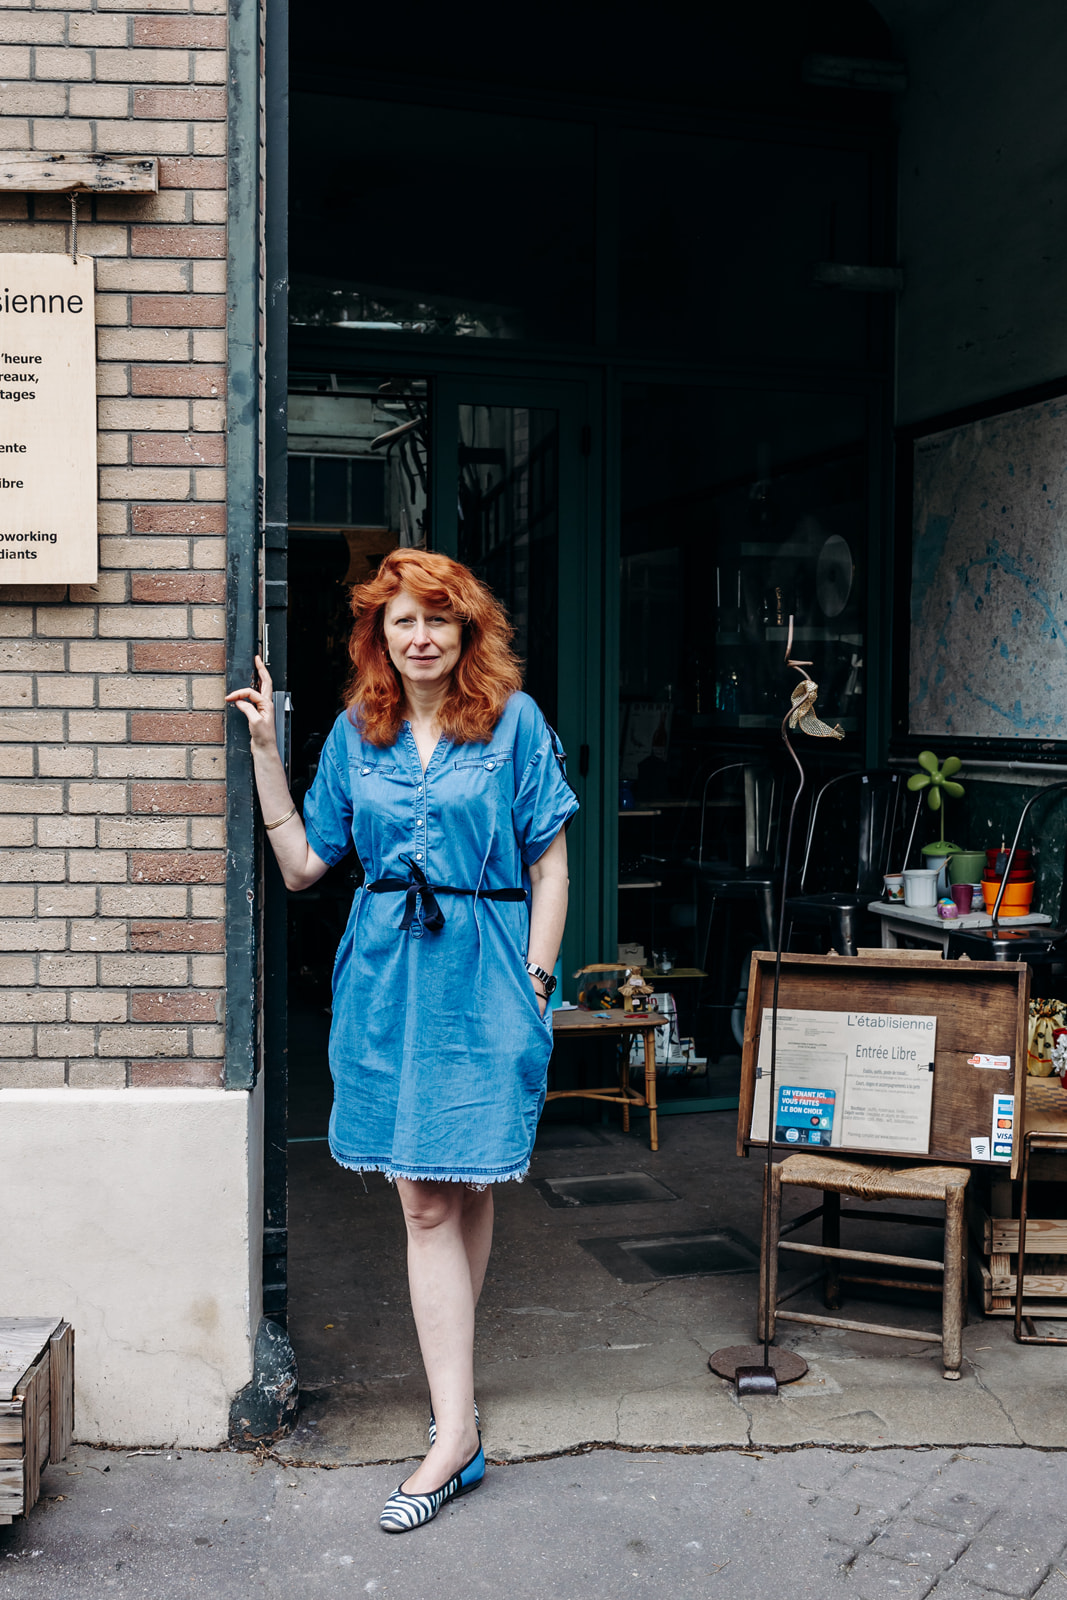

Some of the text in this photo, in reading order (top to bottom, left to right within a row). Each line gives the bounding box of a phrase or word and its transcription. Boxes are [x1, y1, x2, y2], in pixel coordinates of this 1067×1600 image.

[0, 287, 83, 314] ienne
[0, 389, 36, 403] tages
[847, 1015, 934, 1030] L'établisienne
[856, 1044, 917, 1061] Entrée Libre
[791, 1090, 816, 1098] VENANT
[781, 1097, 820, 1107] VOUS FAITES
[789, 1106, 803, 1114] BON
[803, 1107, 823, 1115] CHOIX
[996, 1132, 1013, 1140] VISA
